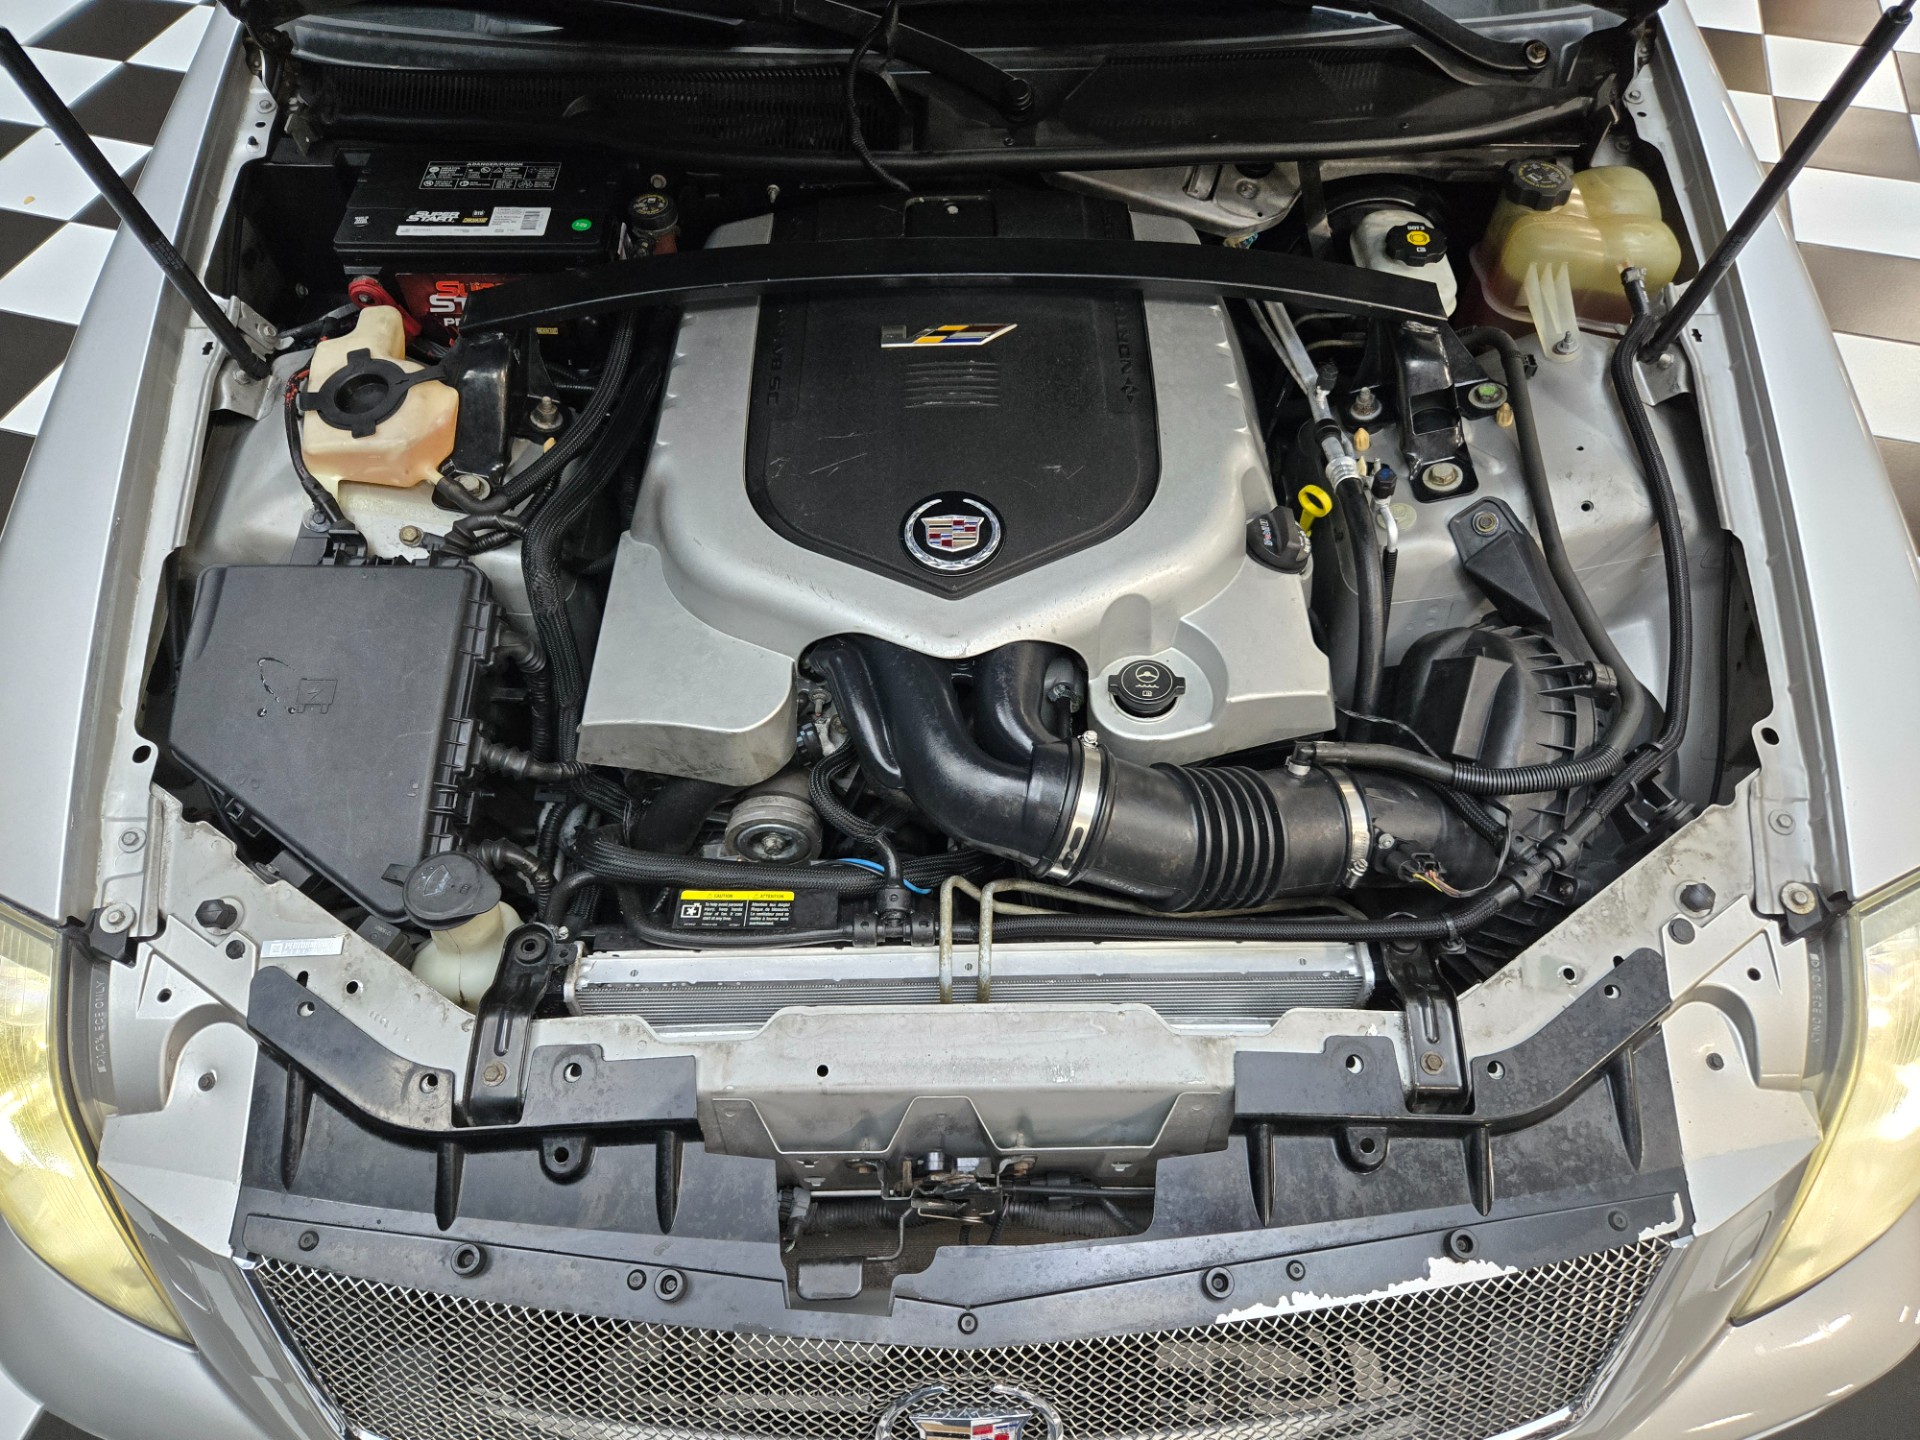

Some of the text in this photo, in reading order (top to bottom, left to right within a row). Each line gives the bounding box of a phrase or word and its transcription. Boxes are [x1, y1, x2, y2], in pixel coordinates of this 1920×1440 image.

[416, 210, 460, 218] SUPER
[94, 980, 105, 1008] ONLY
[94, 1011, 105, 1031] ECE
[1811, 1017, 1823, 1045] ONLY
